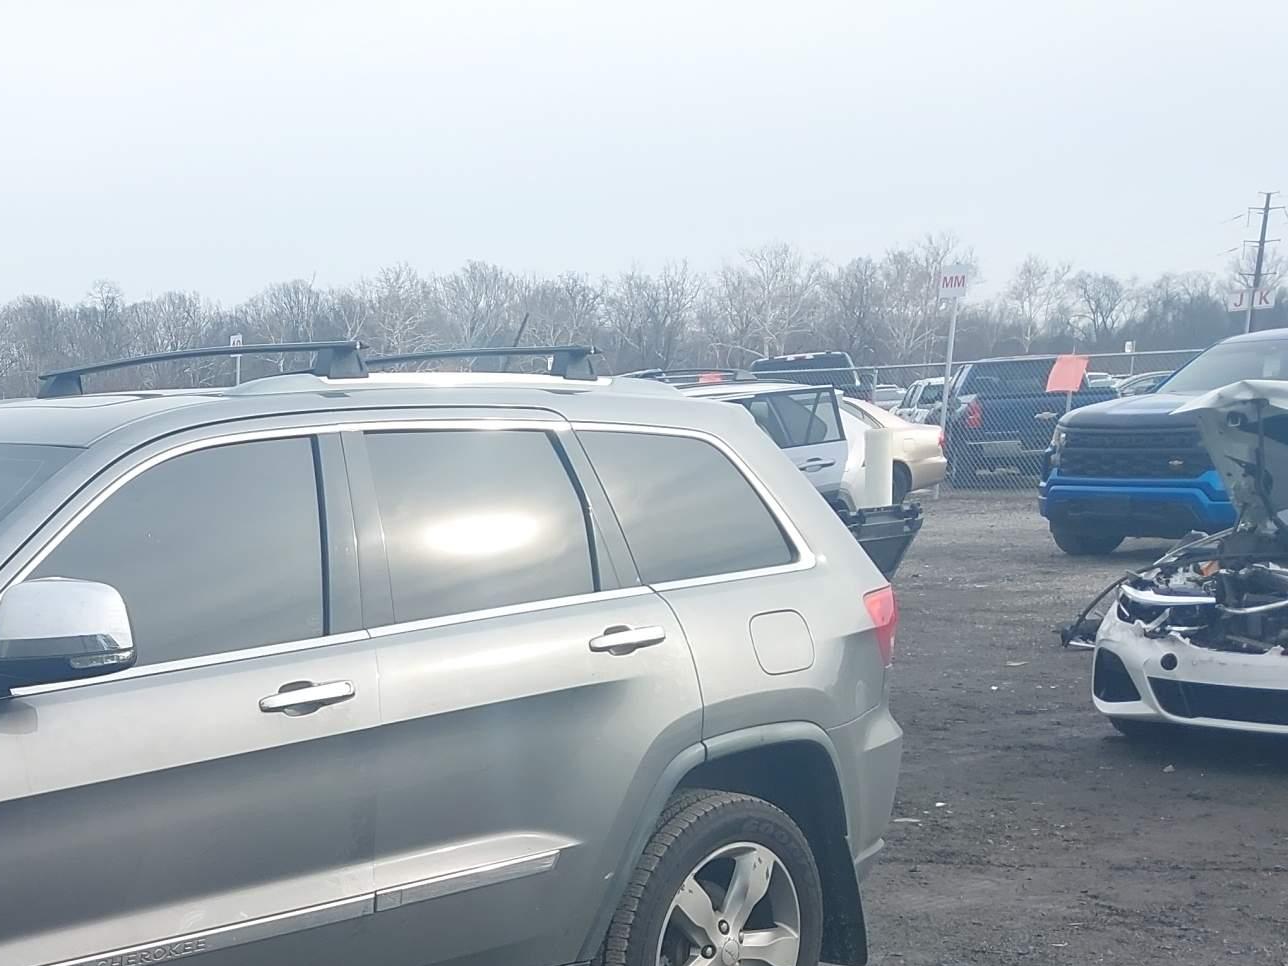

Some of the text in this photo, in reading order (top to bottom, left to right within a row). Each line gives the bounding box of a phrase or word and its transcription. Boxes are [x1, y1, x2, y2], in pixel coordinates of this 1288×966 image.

[941, 275, 966, 289] MM
[1233, 290, 1270, 307] J K
